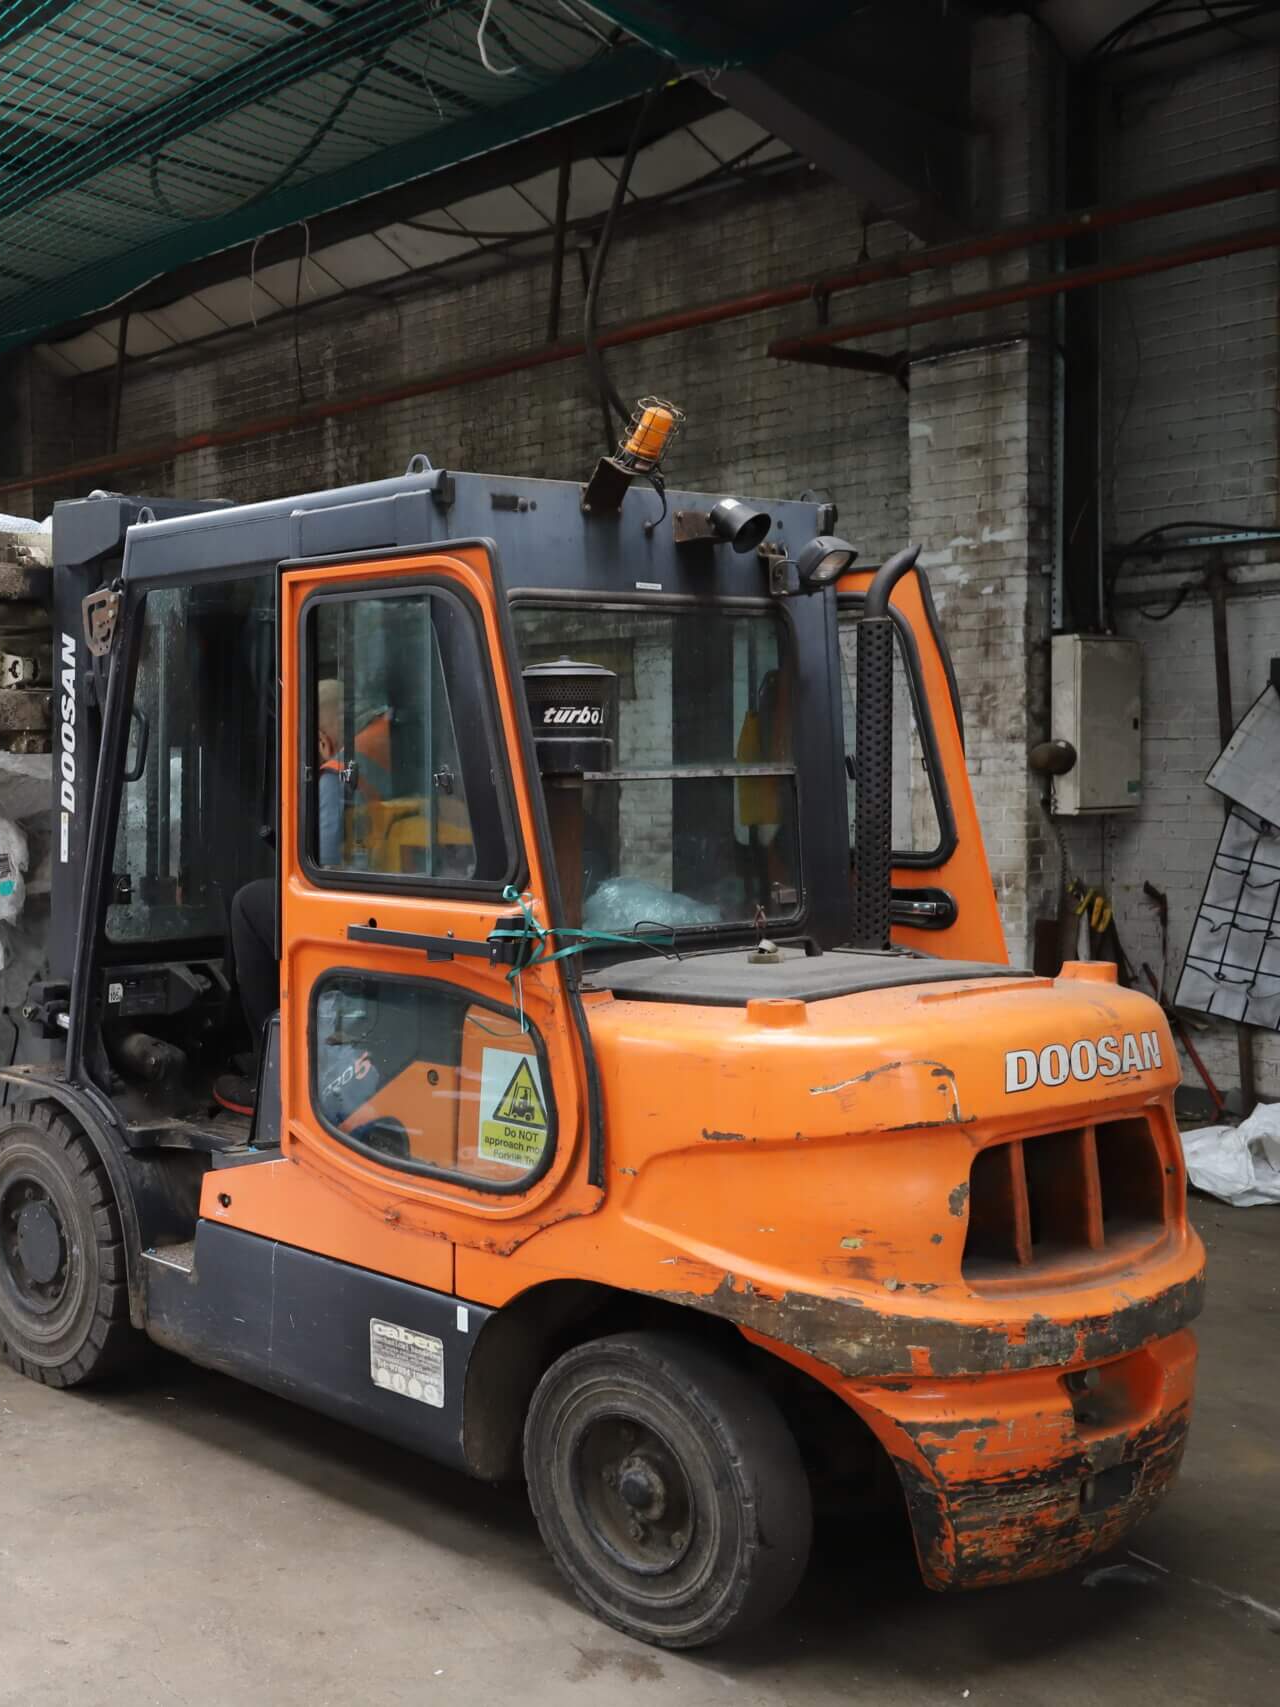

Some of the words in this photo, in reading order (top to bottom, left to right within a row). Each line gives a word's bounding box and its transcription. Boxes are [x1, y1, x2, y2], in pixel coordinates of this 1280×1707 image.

[61, 632, 76, 813] DOOSAN
[1005, 1031, 1162, 1093] DOOSAN
[484, 1135, 524, 1151] approach
[504, 1127, 517, 1138] Do
[518, 1130, 539, 1143] NOT
